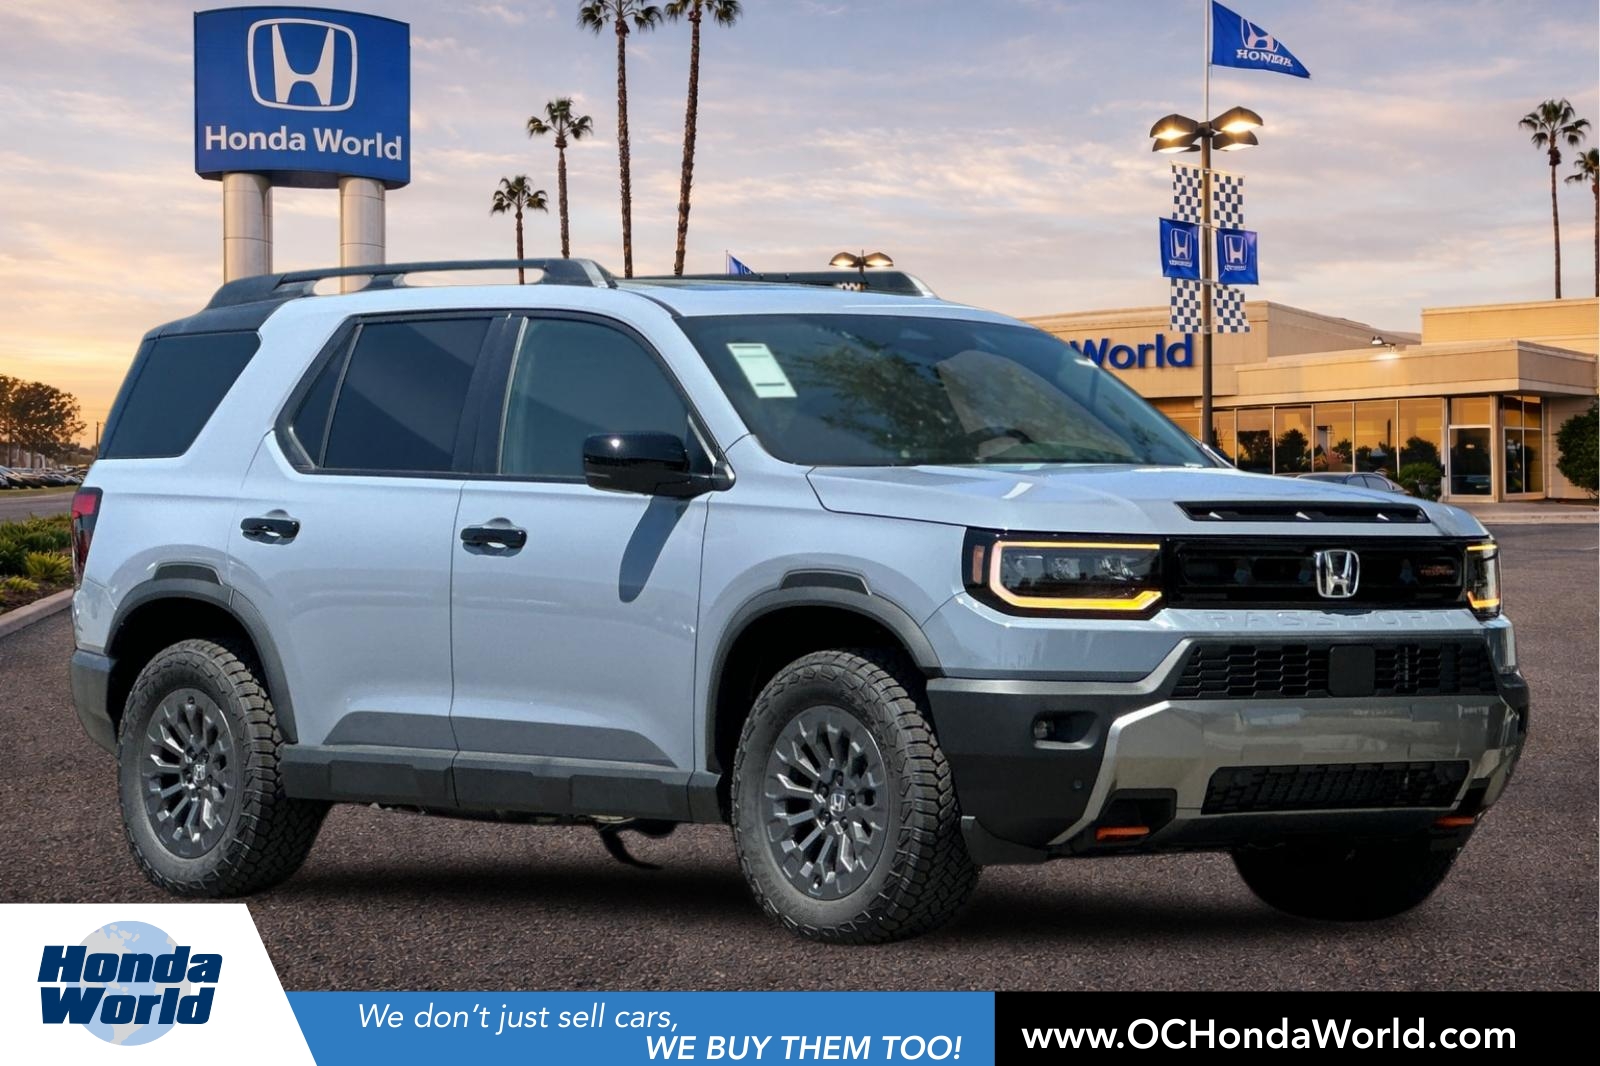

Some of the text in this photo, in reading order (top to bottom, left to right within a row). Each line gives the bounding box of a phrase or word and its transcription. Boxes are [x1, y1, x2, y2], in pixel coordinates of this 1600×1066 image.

[205, 125, 403, 161] Honda World
[1069, 333, 1194, 370] World
